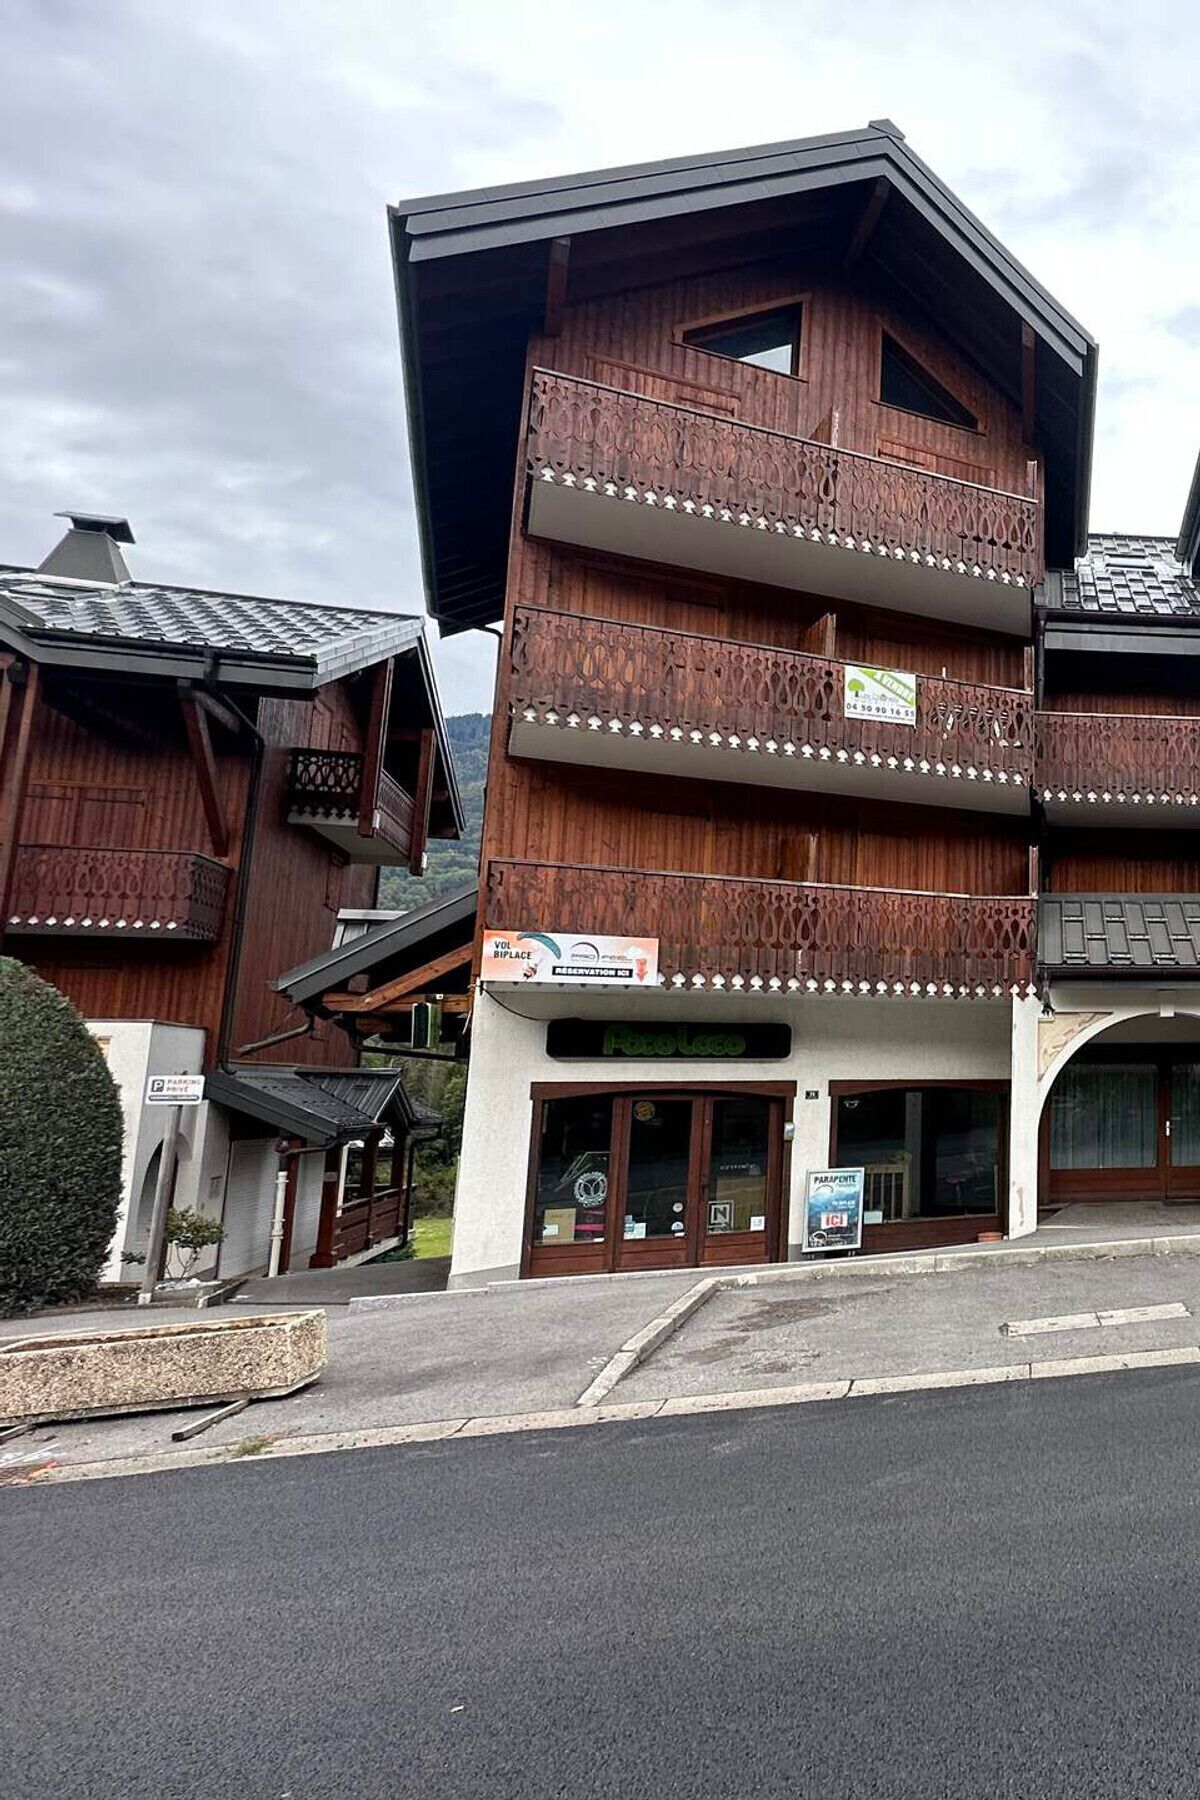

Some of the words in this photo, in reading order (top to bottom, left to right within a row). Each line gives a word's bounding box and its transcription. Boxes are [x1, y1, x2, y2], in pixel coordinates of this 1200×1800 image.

[494, 941, 511, 950] VOL
[493, 950, 533, 960] BIPLACE
[603, 1025, 676, 1055] Poco
[676, 1026, 746, 1056] Loco
[814, 1175, 856, 1184] PARAPENTE
[826, 1214, 844, 1226] ICI
